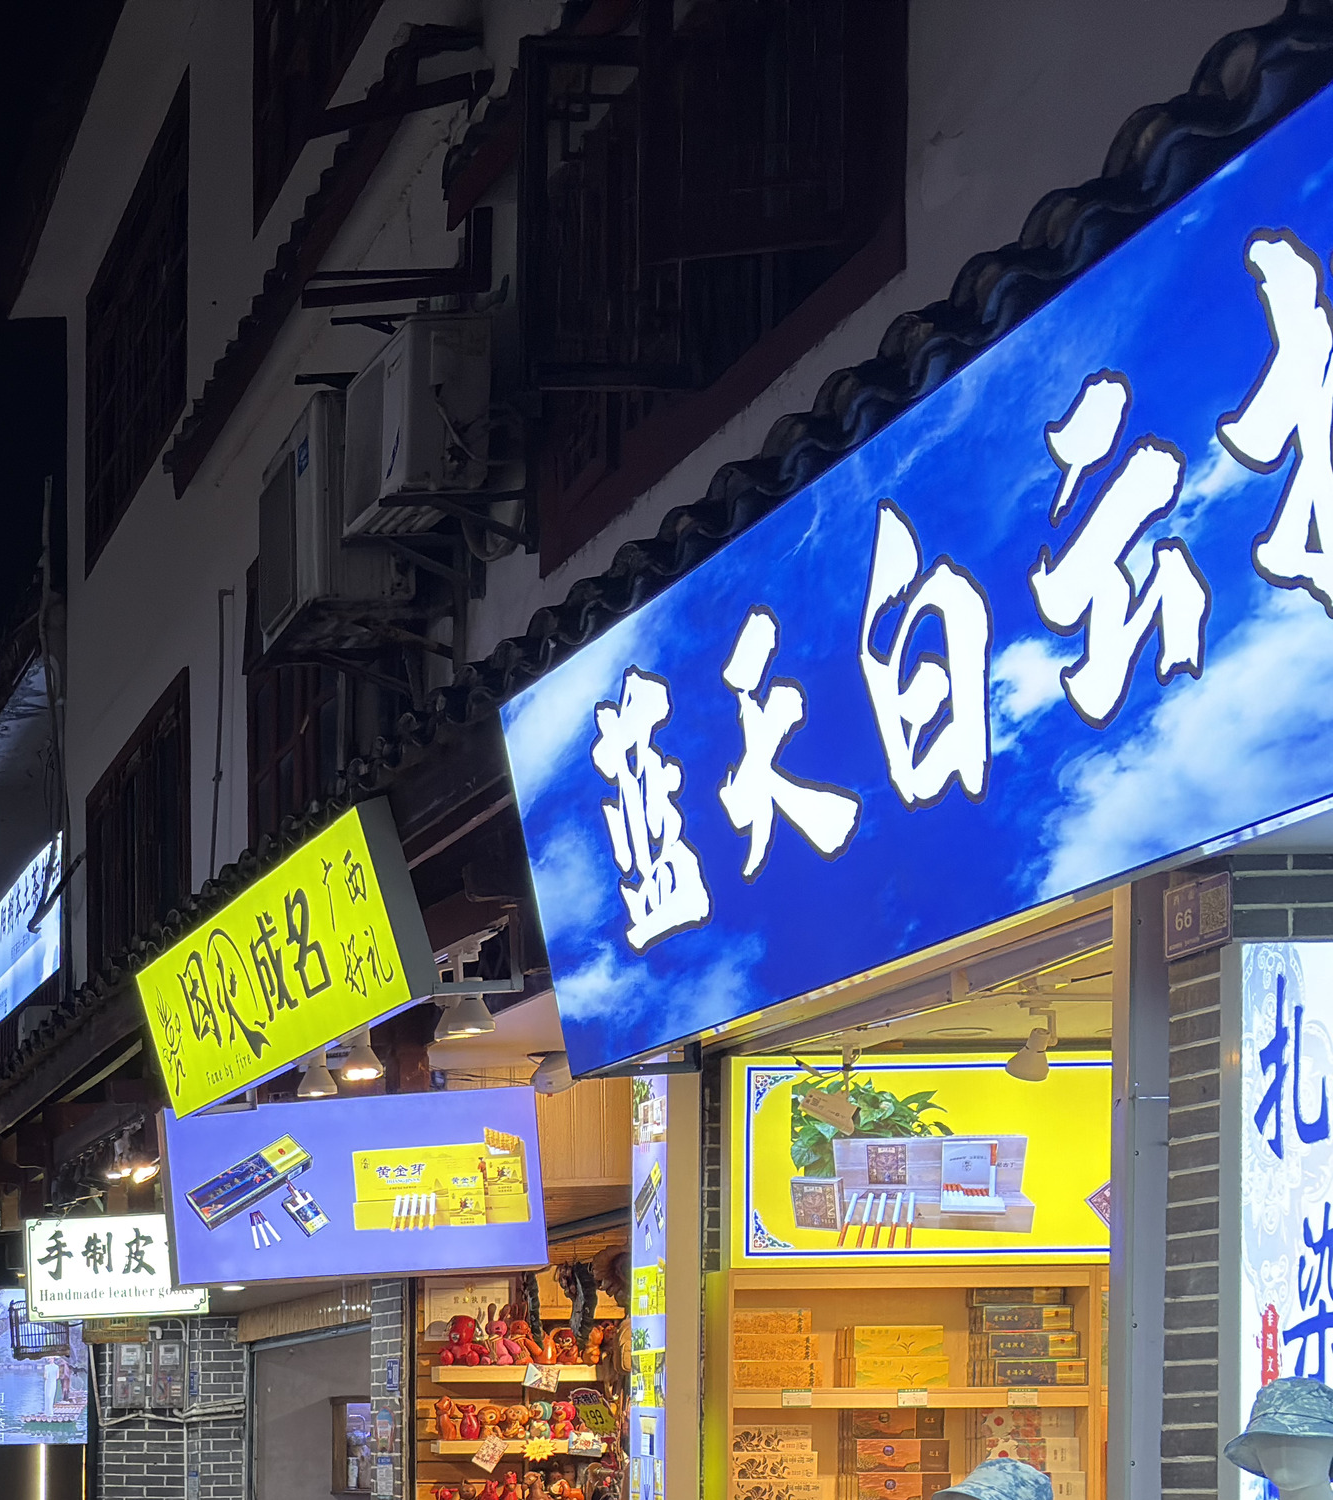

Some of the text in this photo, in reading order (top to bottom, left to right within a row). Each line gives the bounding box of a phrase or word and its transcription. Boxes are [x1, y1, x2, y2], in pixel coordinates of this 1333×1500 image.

[321, 849, 367, 932] 广西
[1175, 908, 1193, 931] 66
[340, 924, 394, 998] 好礼
[376, 1163, 425, 1179] 黄金芽
[37, 1227, 170, 1281] 手制皮
[39, 1288, 105, 1302] Handmade
[108, 1287, 154, 1299] leather
